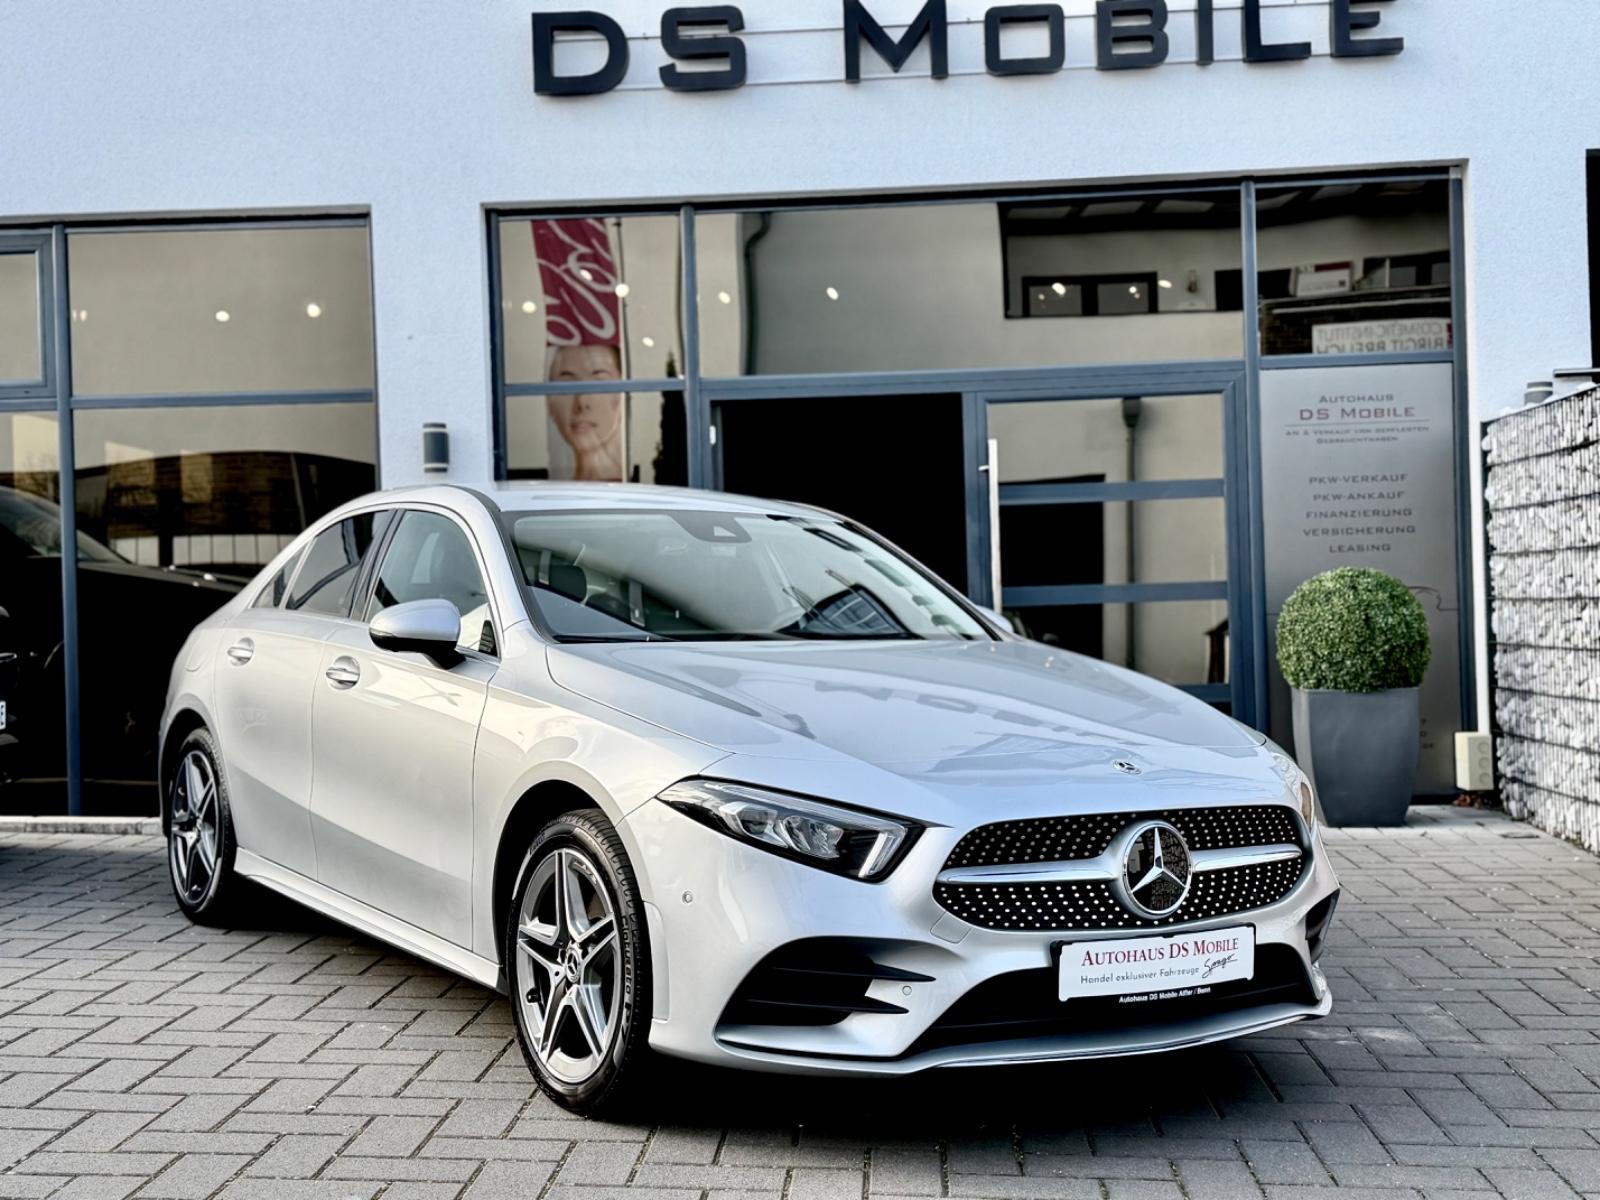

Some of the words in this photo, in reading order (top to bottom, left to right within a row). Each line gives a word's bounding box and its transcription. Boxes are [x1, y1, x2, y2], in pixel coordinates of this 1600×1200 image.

[532, 5, 747, 95] DS
[843, 0, 1404, 84] MOBILE
[1319, 394, 1394, 403] AUTOHAUS
[1300, 409, 1329, 420] DS
[1341, 407, 1415, 418] MOBILE
[1310, 474, 1408, 484] PKW-VERKAUF
[1313, 491, 1405, 501] PKW-ANKAUF
[1306, 509, 1412, 519] FINANZIERUNG
[1303, 525, 1416, 536] VERSICHERUNG
[1329, 543, 1391, 554] LEASING
[1081, 946, 1164, 966] AUTOHAUS
[1169, 942, 1189, 958] DS
[1193, 937, 1239, 956] MOBILE
[1081, 973, 1113, 984] Handel
[1115, 970, 1157, 982] exklusiver
[1159, 967, 1200, 977] Fahrzeuge
[1119, 995, 1149, 1003] Autohaus
[1159, 991, 1178, 999] Mobile
